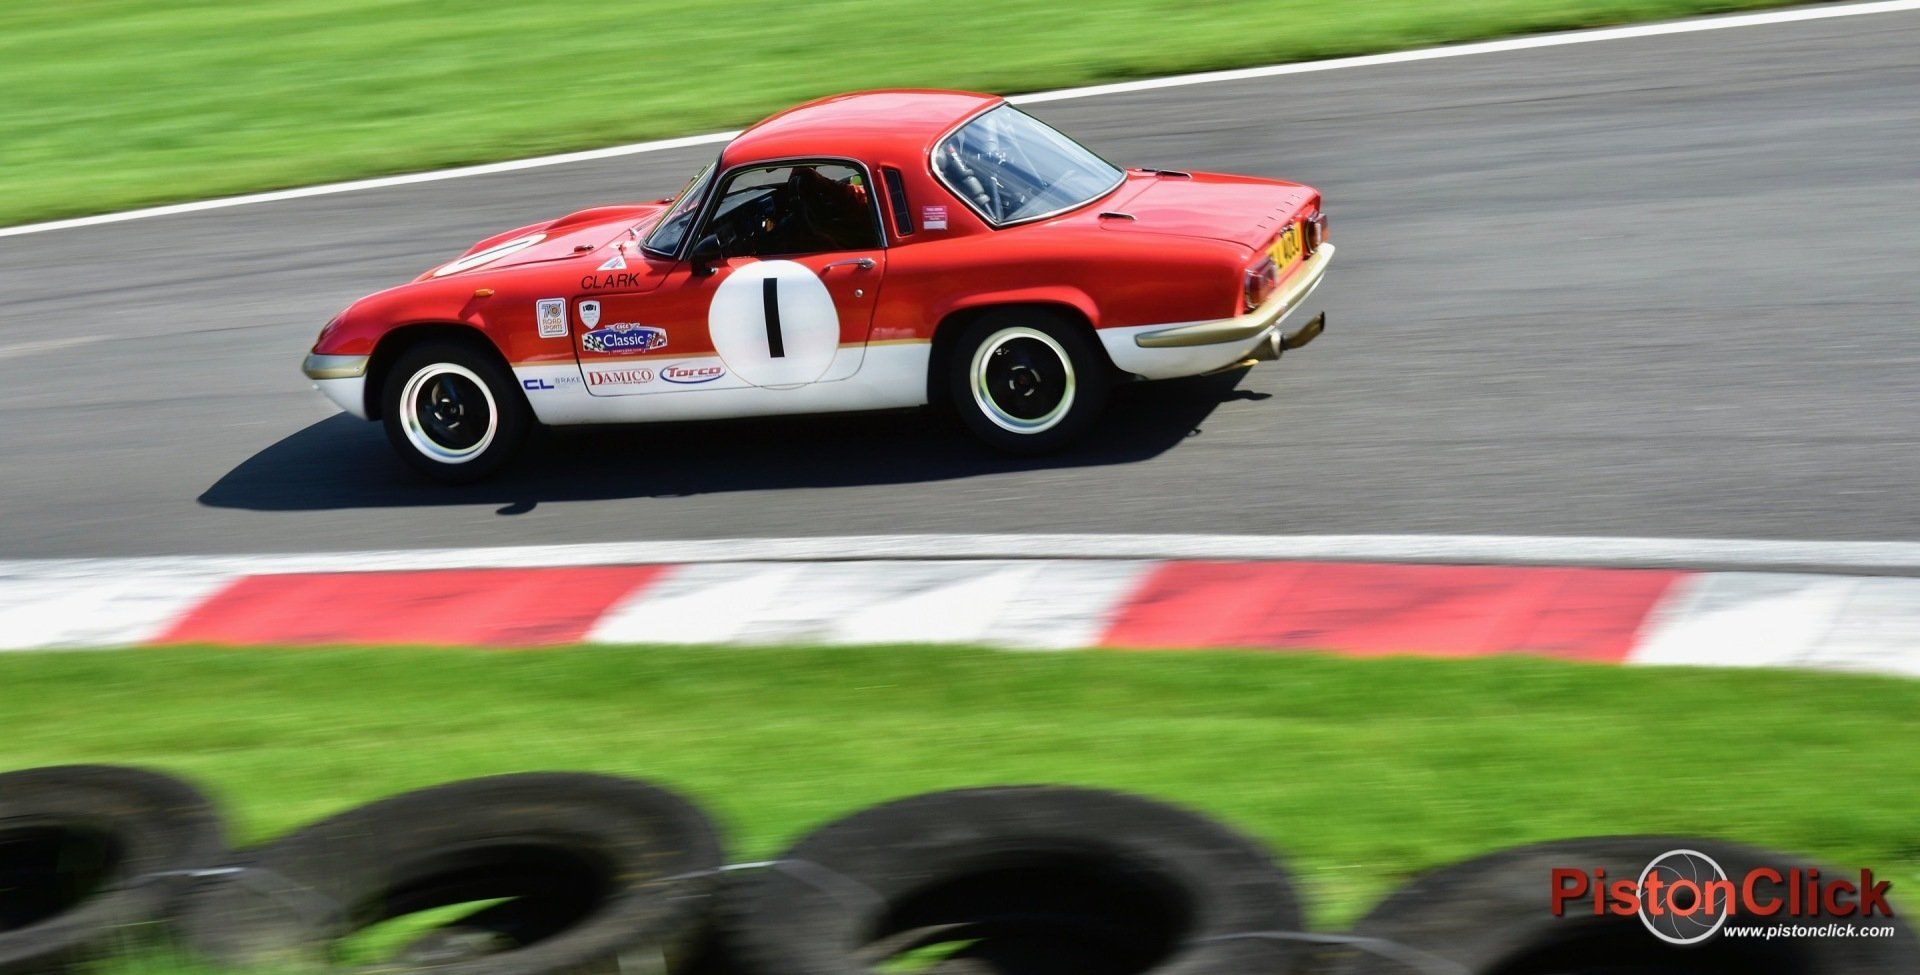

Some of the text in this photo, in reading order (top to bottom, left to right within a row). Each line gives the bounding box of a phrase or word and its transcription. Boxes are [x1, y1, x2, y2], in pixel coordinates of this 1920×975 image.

[581, 273, 640, 290] CLARK
[763, 277, 785, 358] 1
[603, 334, 645, 347] Classic
[523, 379, 554, 390] CL
[589, 370, 652, 385] DAMICO
